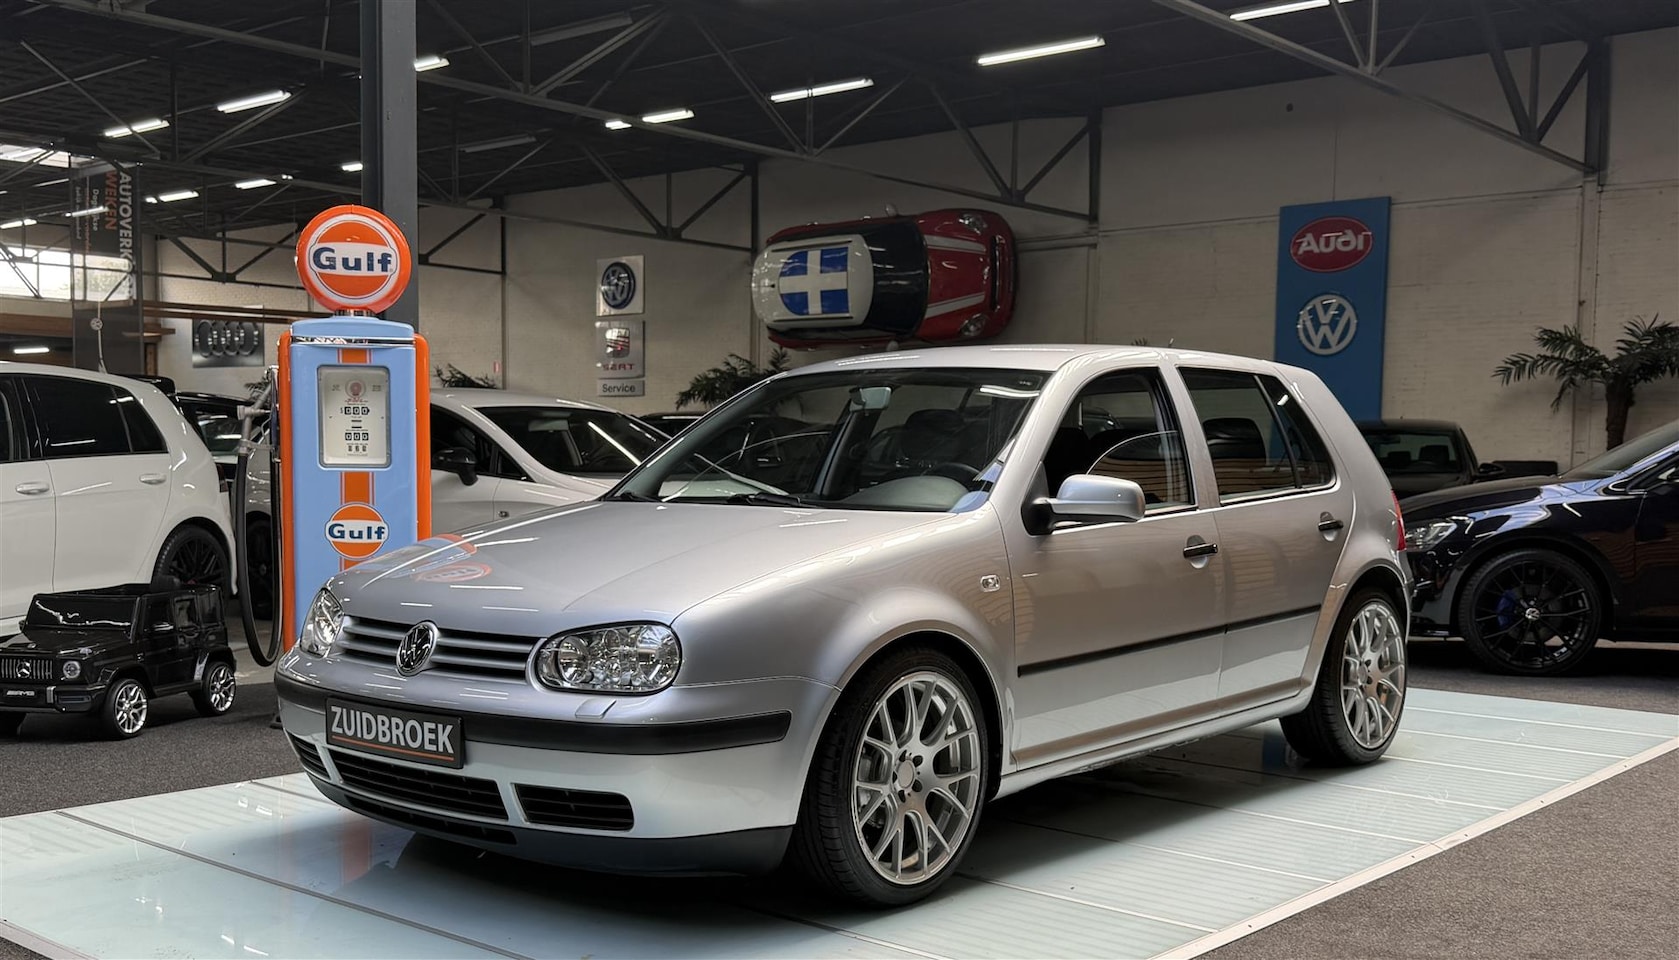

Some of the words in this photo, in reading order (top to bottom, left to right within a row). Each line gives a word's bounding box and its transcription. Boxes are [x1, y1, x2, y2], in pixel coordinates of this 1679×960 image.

[105, 169, 118, 231] WEKEN
[1297, 229, 1365, 255] Audi
[312, 247, 392, 273] Gulf
[602, 383, 636, 393] Service
[328, 523, 386, 540] Gulf
[330, 705, 454, 754] ZUIDBROEK
